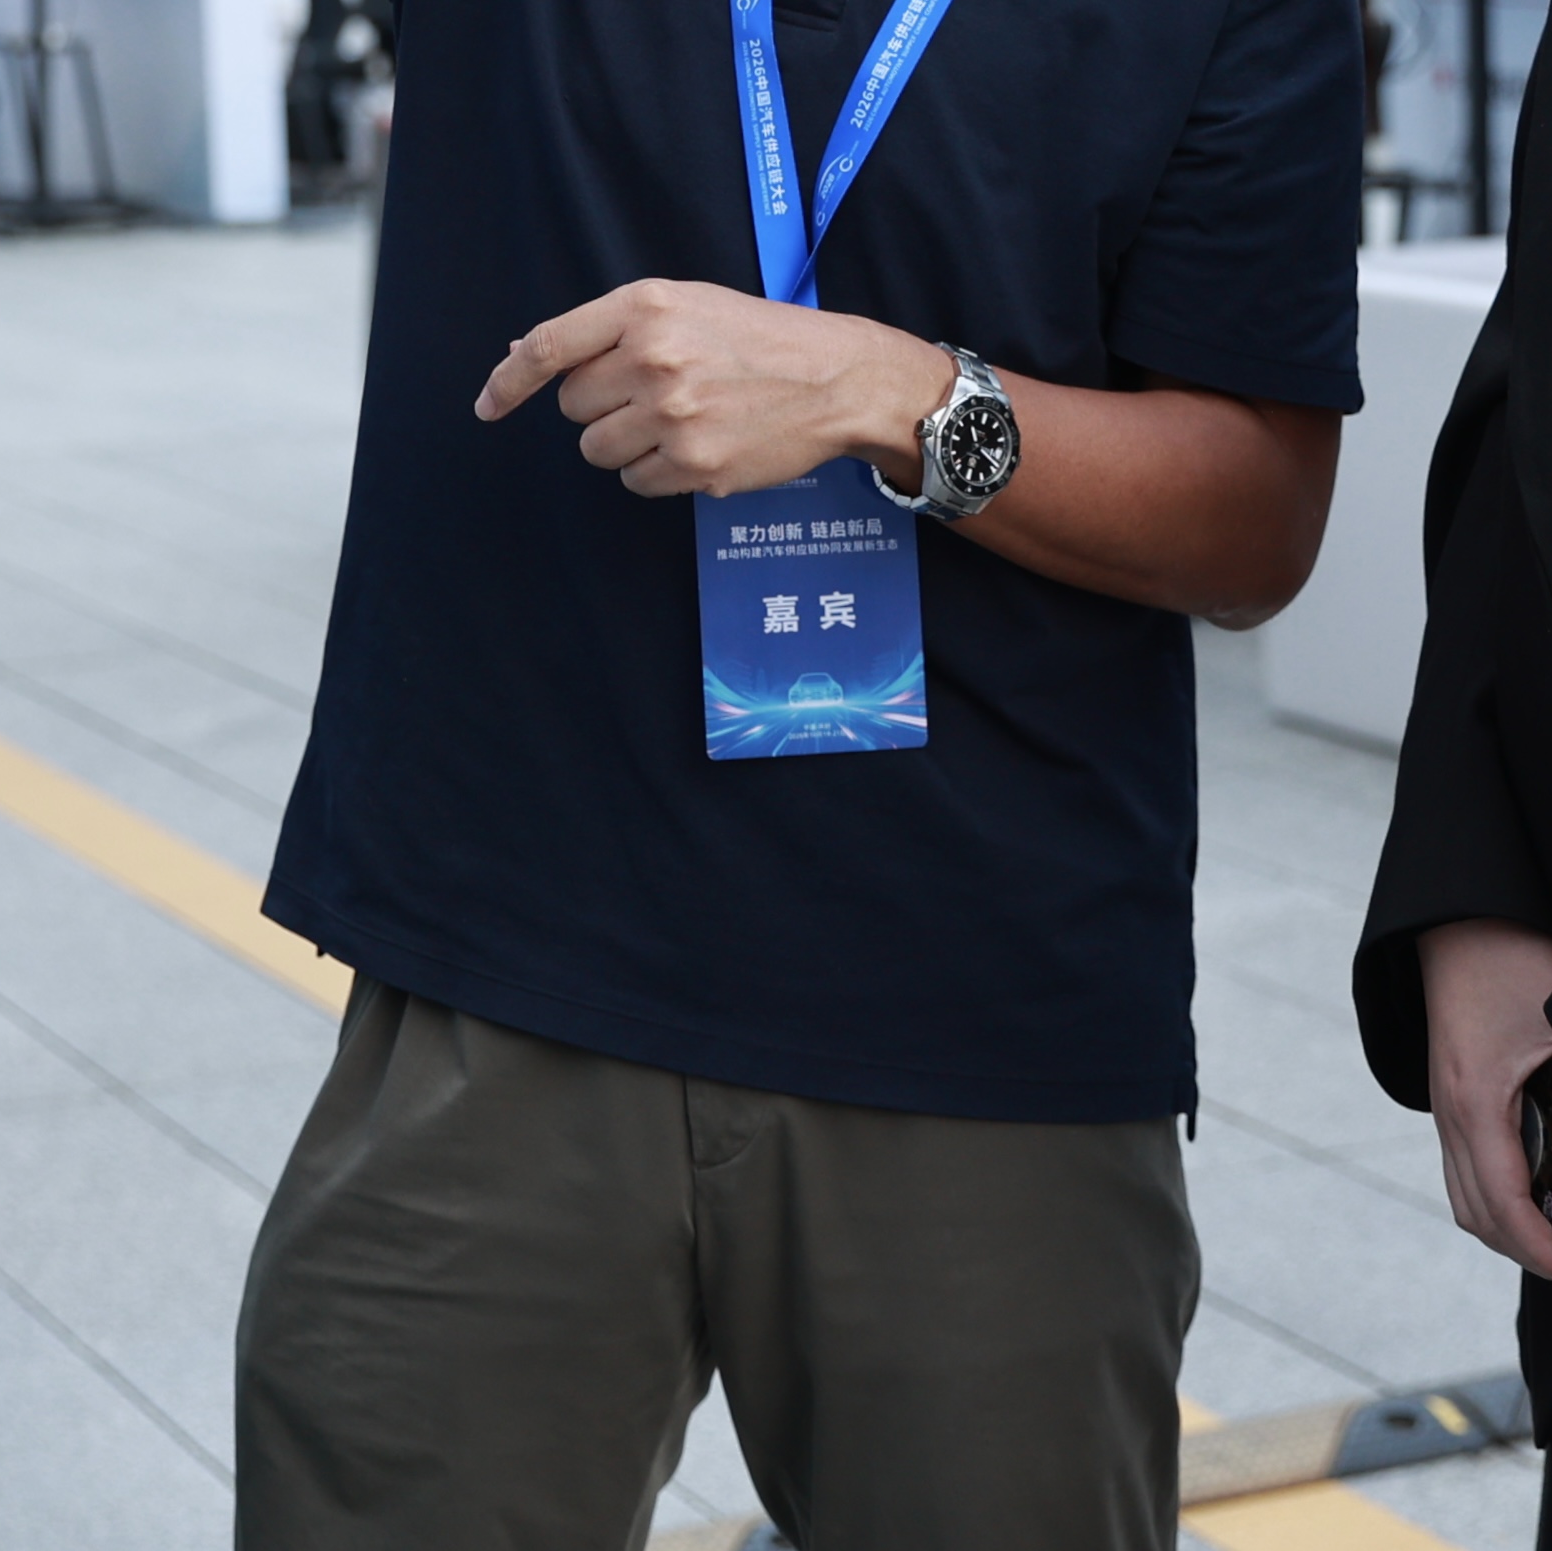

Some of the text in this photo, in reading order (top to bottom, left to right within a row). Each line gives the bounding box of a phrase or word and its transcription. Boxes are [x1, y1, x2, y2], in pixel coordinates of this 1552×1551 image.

[749, 38, 789, 216] 2026中国汽车供应链大会
[731, 518, 883, 544] 聚力创新 链启新局
[717, 539, 898, 560] 推动构建汽车供应链协同发展新生态
[762, 591, 856, 634] 嘉 宾
